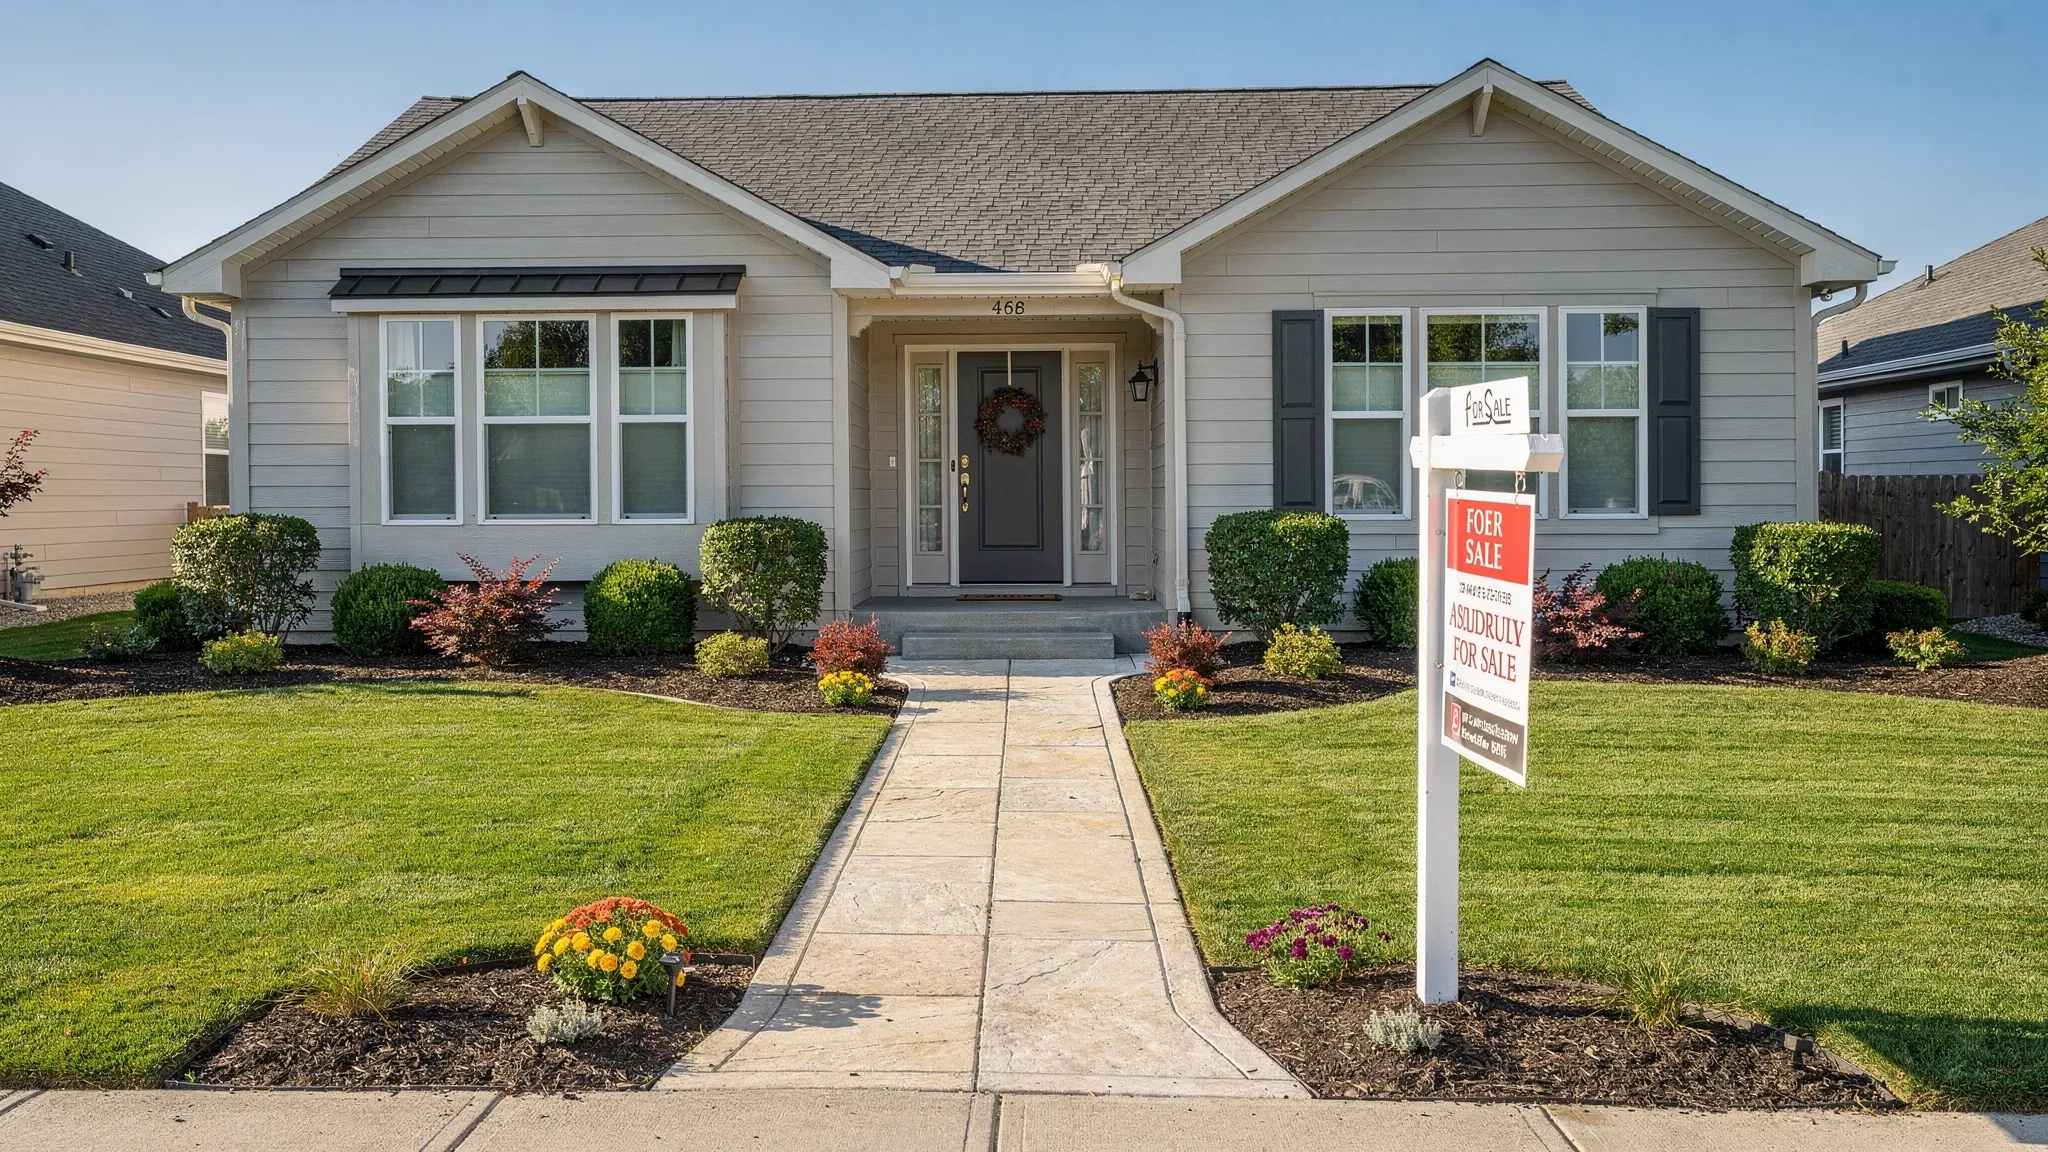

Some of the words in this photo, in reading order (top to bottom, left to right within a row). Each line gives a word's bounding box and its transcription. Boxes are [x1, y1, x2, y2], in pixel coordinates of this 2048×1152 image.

[992, 300, 1025, 315] 468
[1466, 508, 1503, 538] FOER
[1465, 538, 1503, 571] SALE
[1453, 636, 1478, 670] FOR
[1480, 646, 1517, 683] SALE
